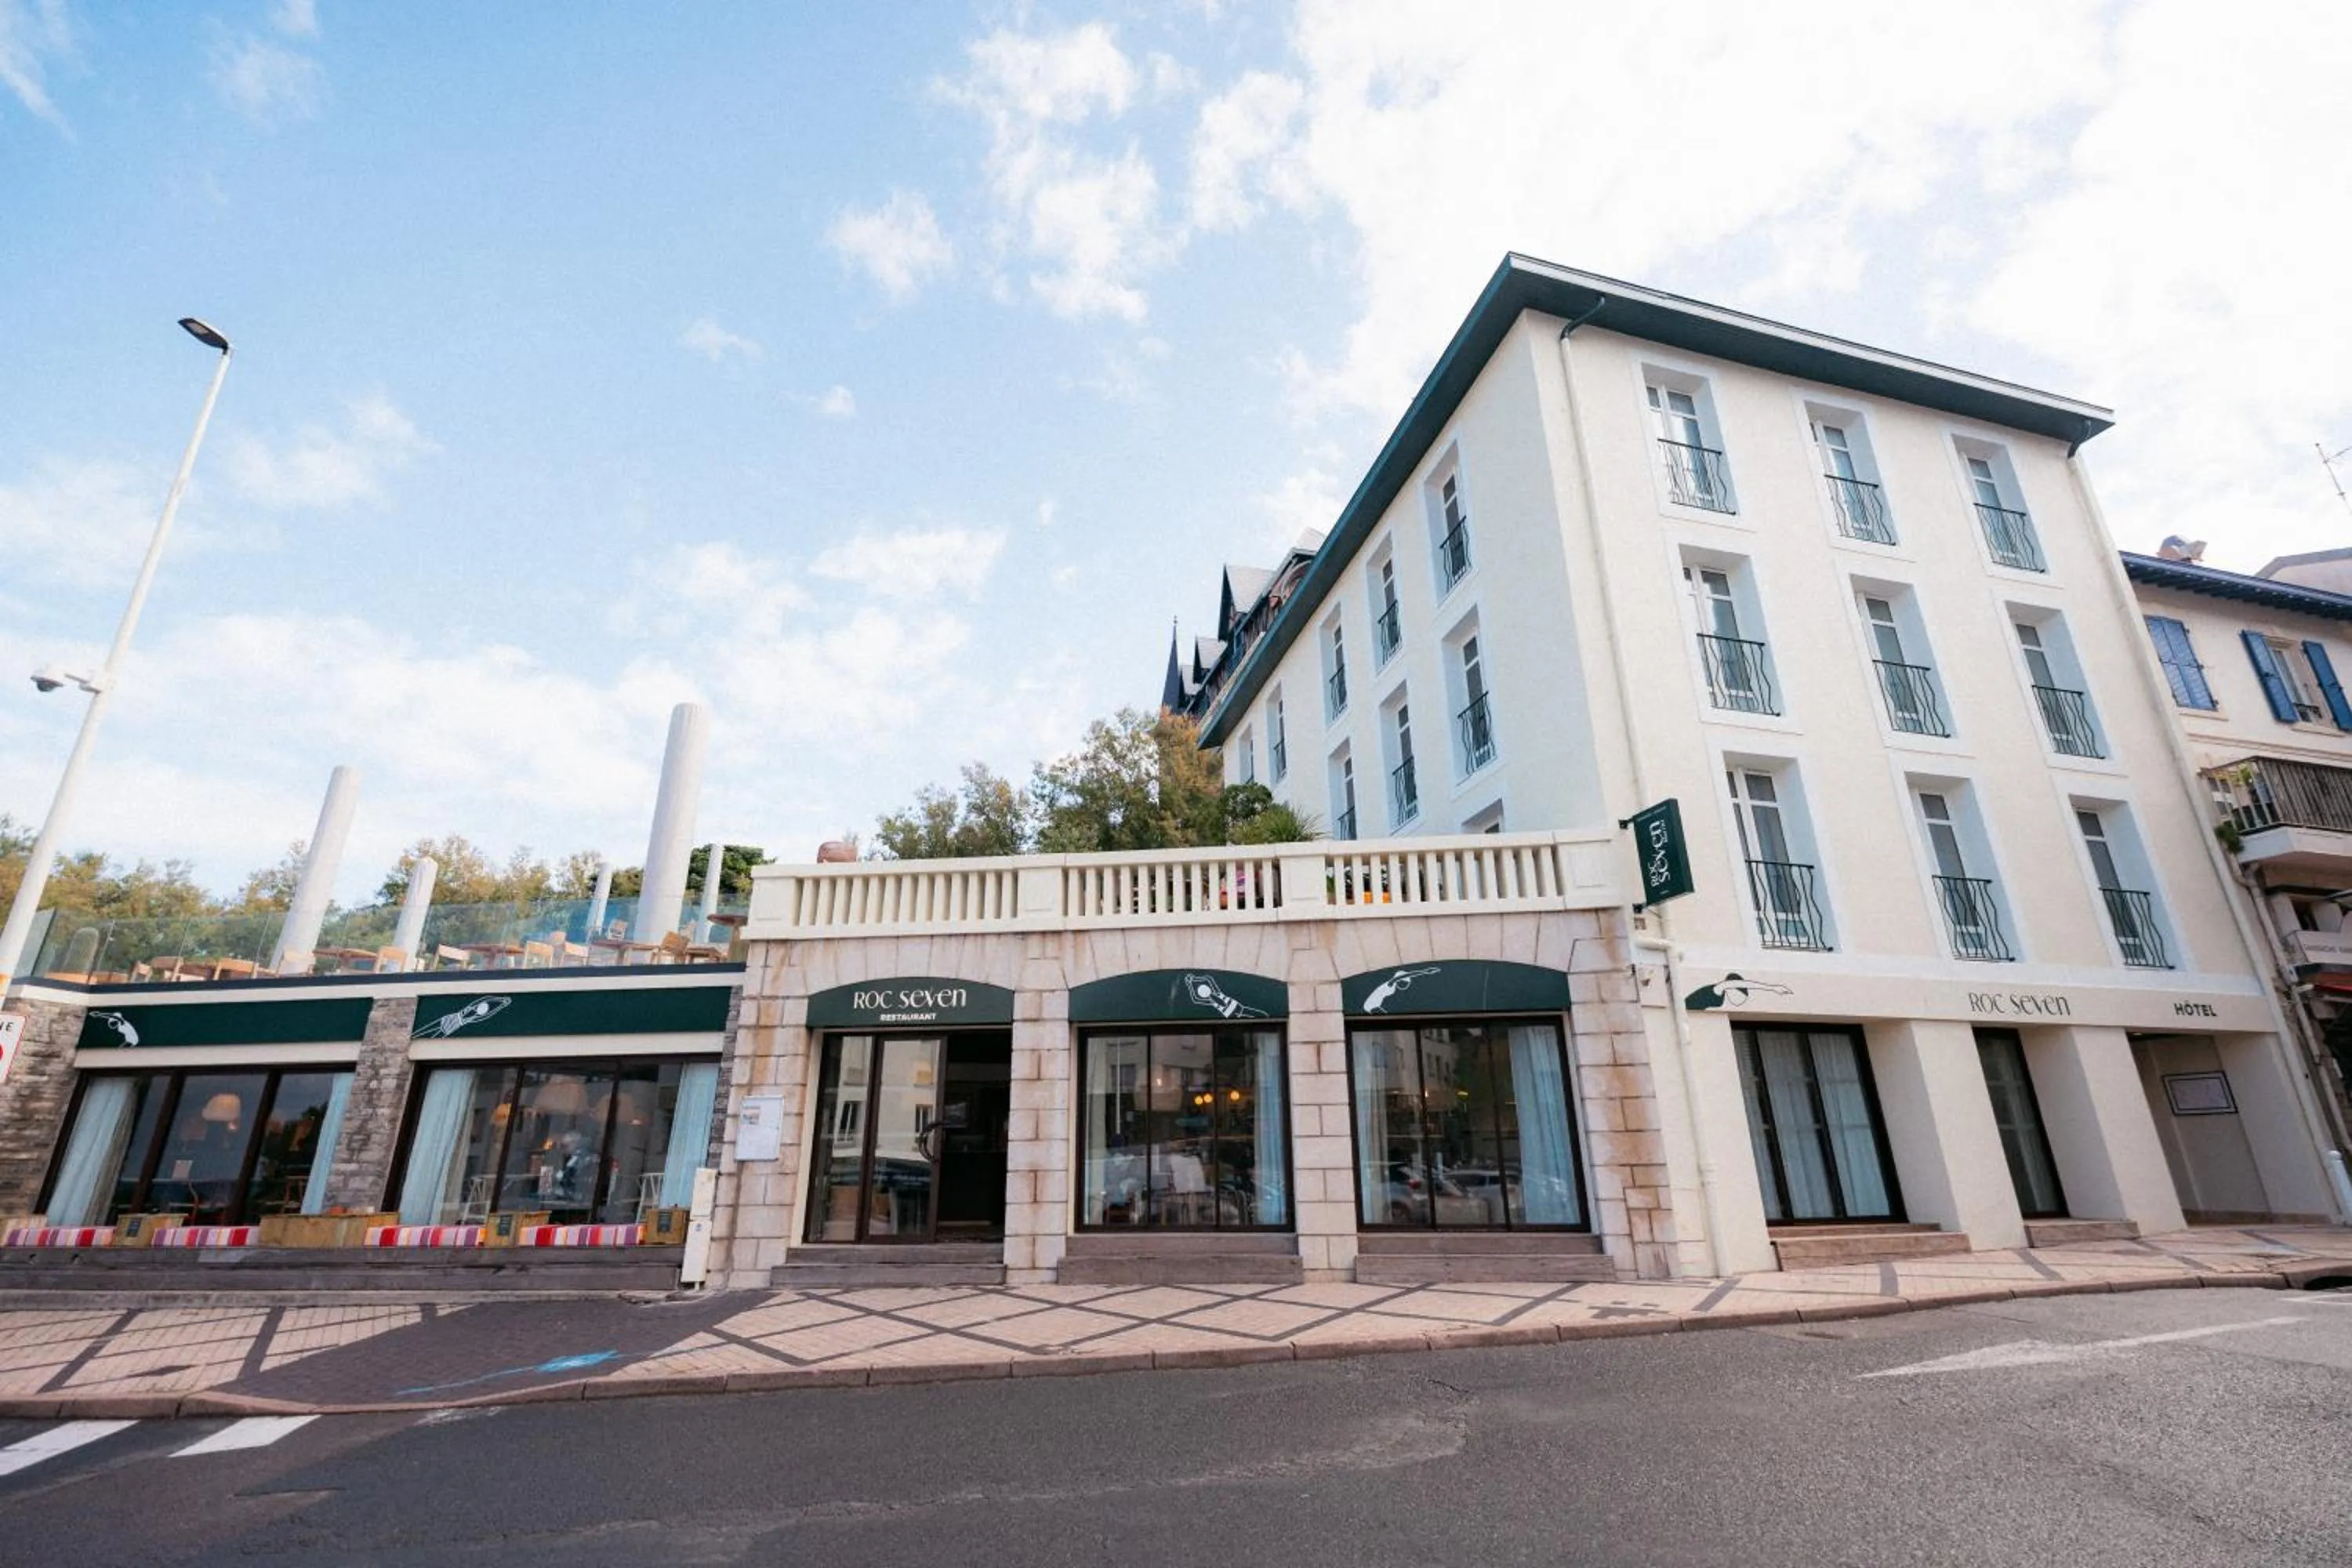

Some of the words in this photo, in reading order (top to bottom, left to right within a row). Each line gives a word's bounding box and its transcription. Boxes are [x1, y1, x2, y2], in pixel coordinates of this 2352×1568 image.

[853, 990, 893, 1009] ROC
[1969, 993, 2005, 1014] ROC
[2174, 1000, 2218, 1017] HÔTEL
